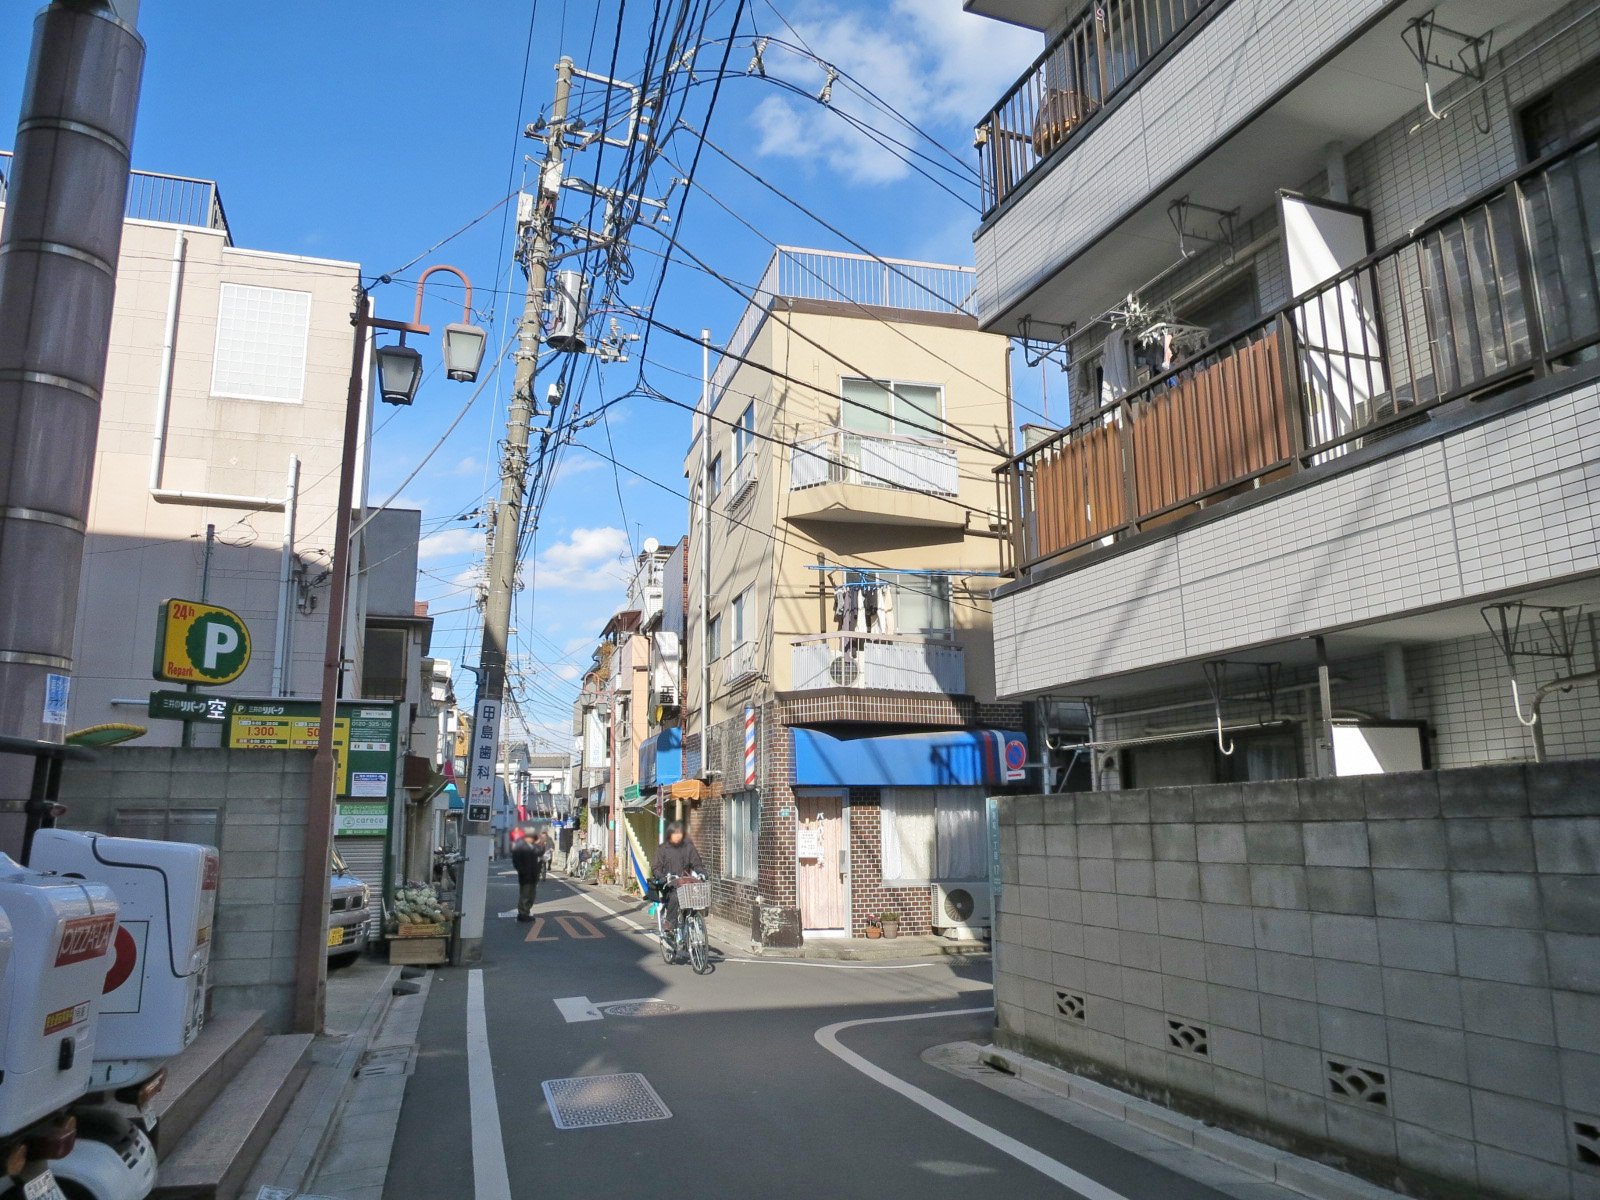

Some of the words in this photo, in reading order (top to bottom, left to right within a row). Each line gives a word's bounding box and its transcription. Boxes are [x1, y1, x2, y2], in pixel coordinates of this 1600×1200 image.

[173, 604, 195, 620] 24h
[203, 622, 239, 669] P
[167, 662, 194, 677] Repark
[207, 699, 226, 719] 空
